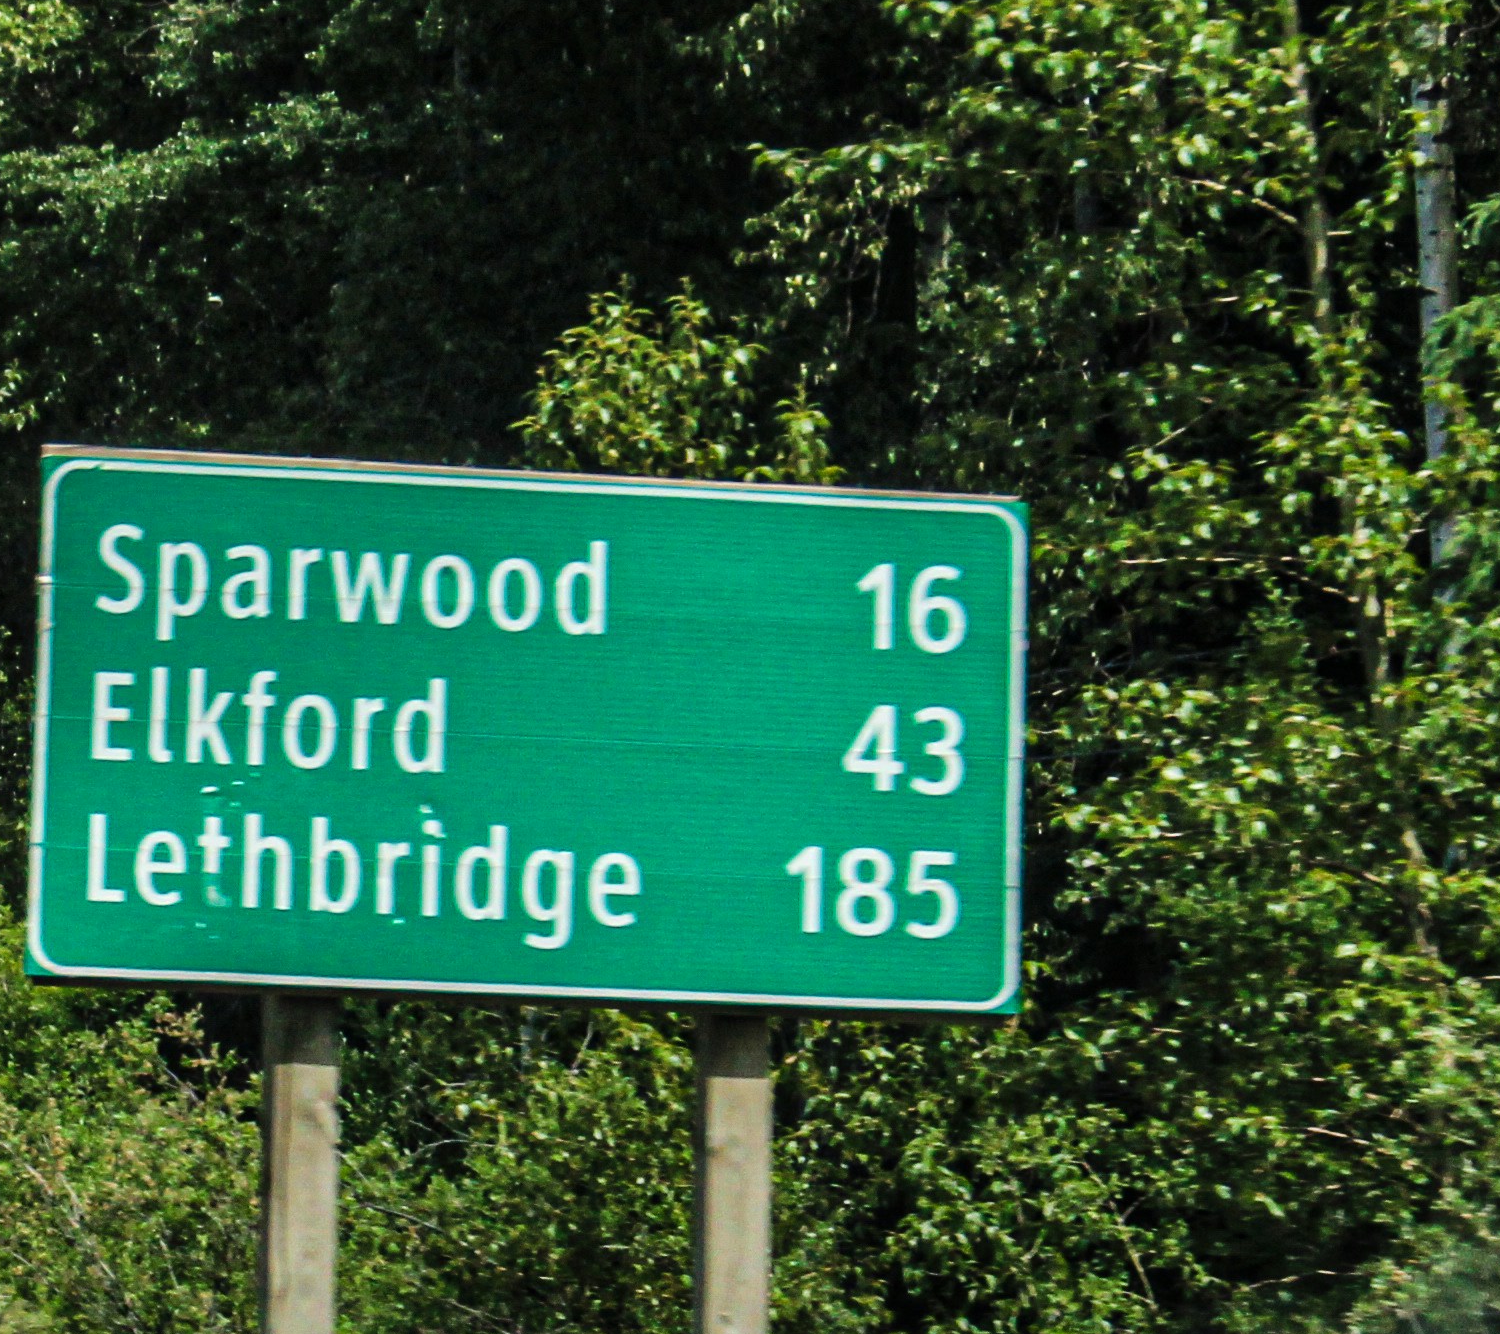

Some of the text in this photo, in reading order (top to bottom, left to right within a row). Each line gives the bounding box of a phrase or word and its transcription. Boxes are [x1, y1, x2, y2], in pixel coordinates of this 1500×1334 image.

[95, 522, 967, 655] Sparwood 16
[90, 666, 964, 797] Elkford 43
[86, 813, 959, 951] Lethbridge 185
